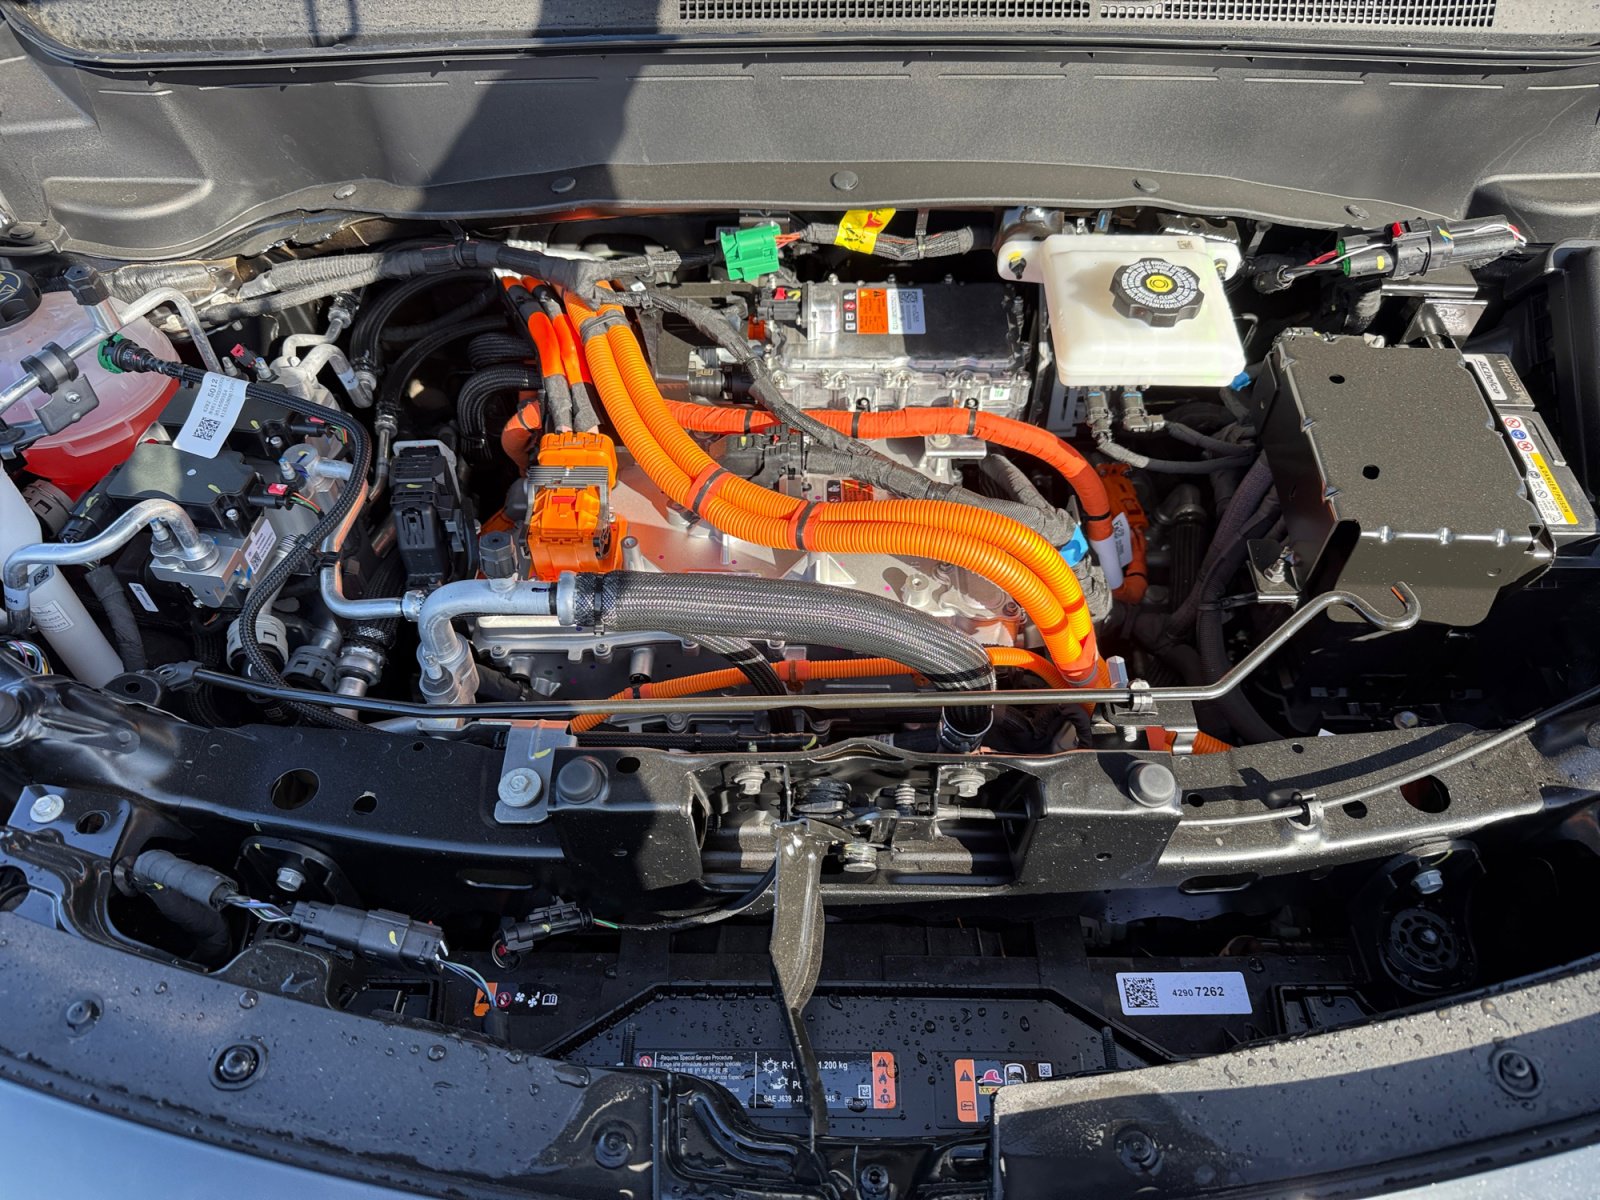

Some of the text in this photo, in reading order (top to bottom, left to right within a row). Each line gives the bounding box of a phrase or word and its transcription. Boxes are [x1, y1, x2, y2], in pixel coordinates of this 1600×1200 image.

[1478, 360, 1501, 394] ACDelco
[208, 378, 219, 398] 5012
[1172, 986, 1224, 997] 4290 7262
[660, 1054, 679, 1062] Requires
[679, 1054, 695, 1062] Special
[818, 1061, 837, 1069] 1.200
[838, 1061, 848, 1071] kg
[763, 1095, 776, 1103] SAE
